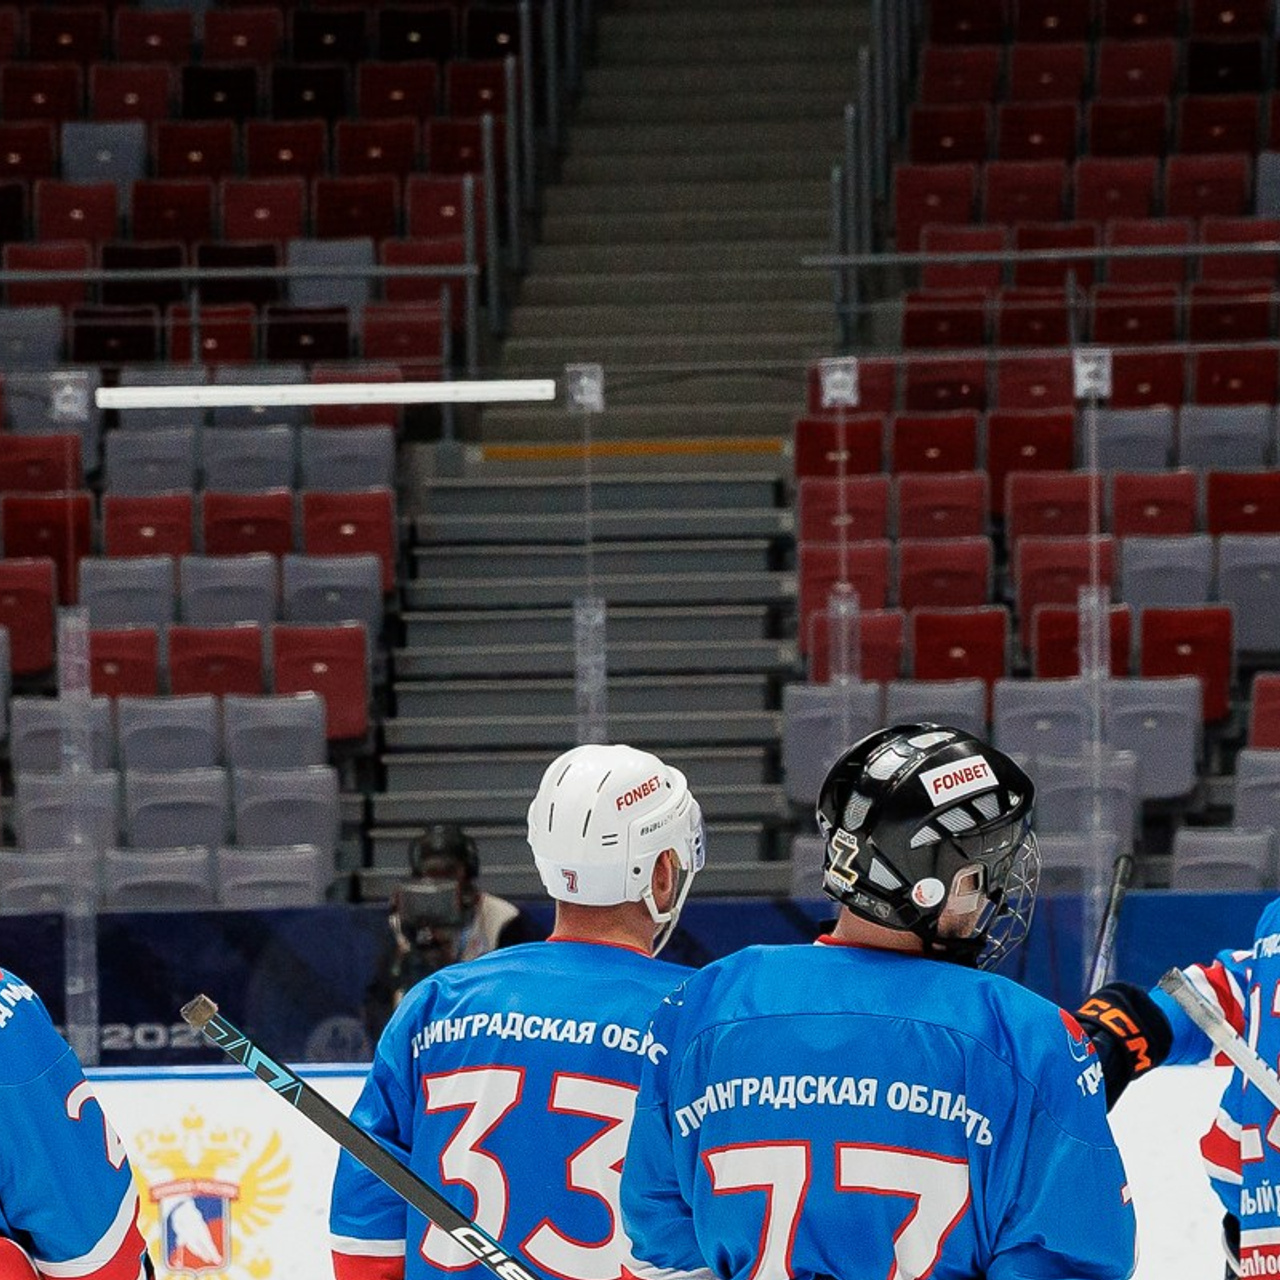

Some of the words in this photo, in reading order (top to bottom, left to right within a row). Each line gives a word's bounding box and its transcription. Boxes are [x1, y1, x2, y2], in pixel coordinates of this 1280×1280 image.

[615, 775, 662, 811] FONBET
[932, 762, 989, 795] FONBET
[101, 1022, 206, 1050] 202
[1078, 998, 1151, 1072] CCM
